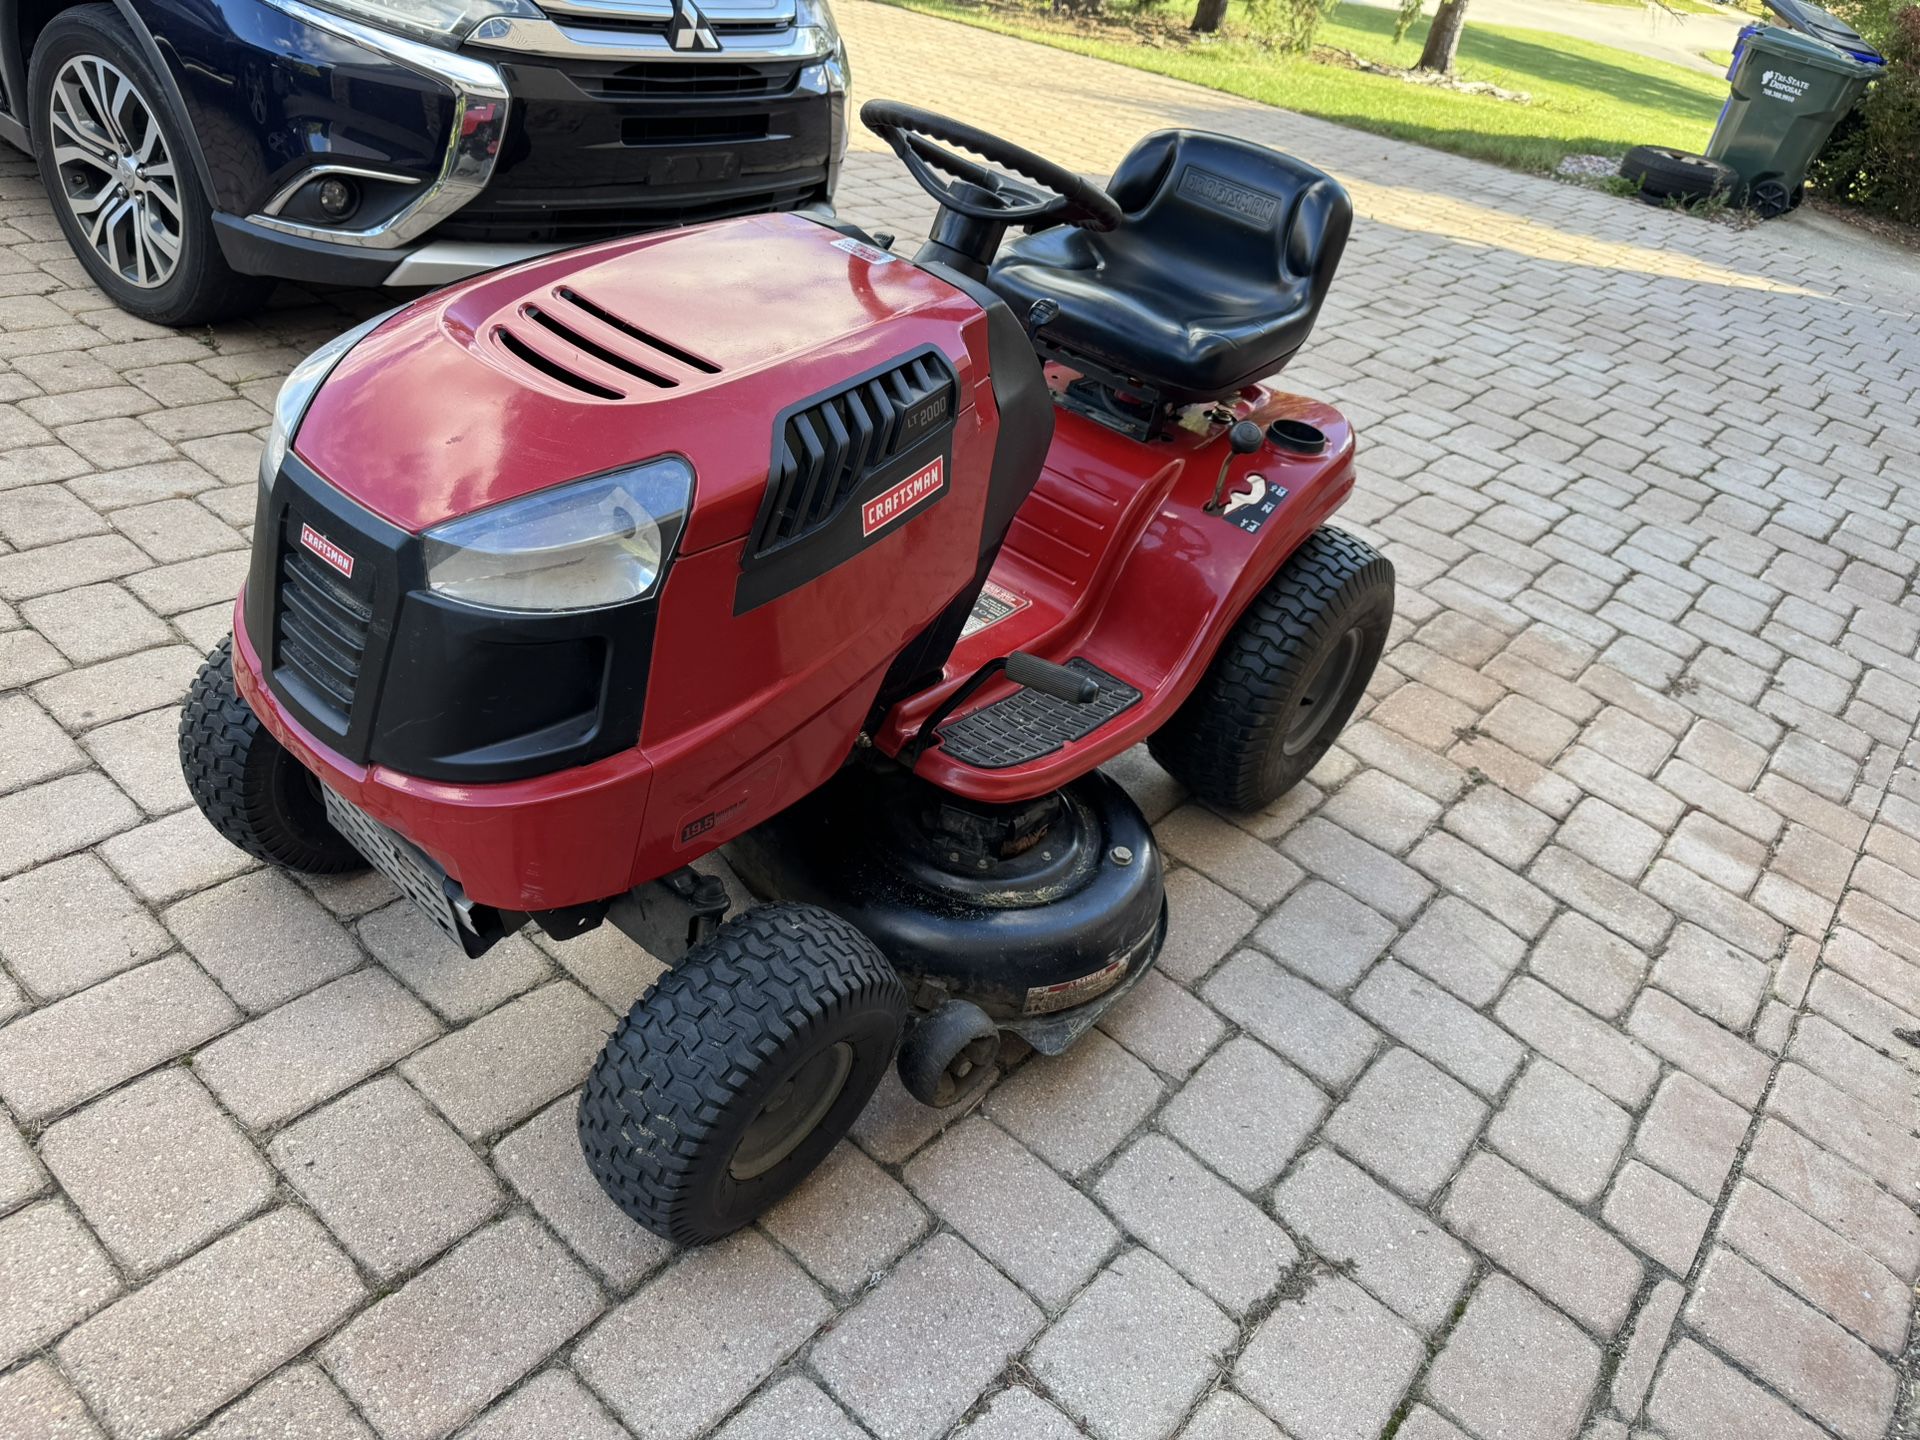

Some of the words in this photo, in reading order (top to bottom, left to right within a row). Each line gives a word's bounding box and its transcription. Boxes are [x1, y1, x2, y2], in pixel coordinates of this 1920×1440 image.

[1186, 174, 1275, 220] CRAFTSMAN
[907, 412, 919, 429] LT
[920, 396, 947, 426] 2000
[868, 466, 939, 525] CRAFTSMAN
[304, 530, 350, 570] CRAFTSMAN
[682, 815, 714, 841] 19.5
